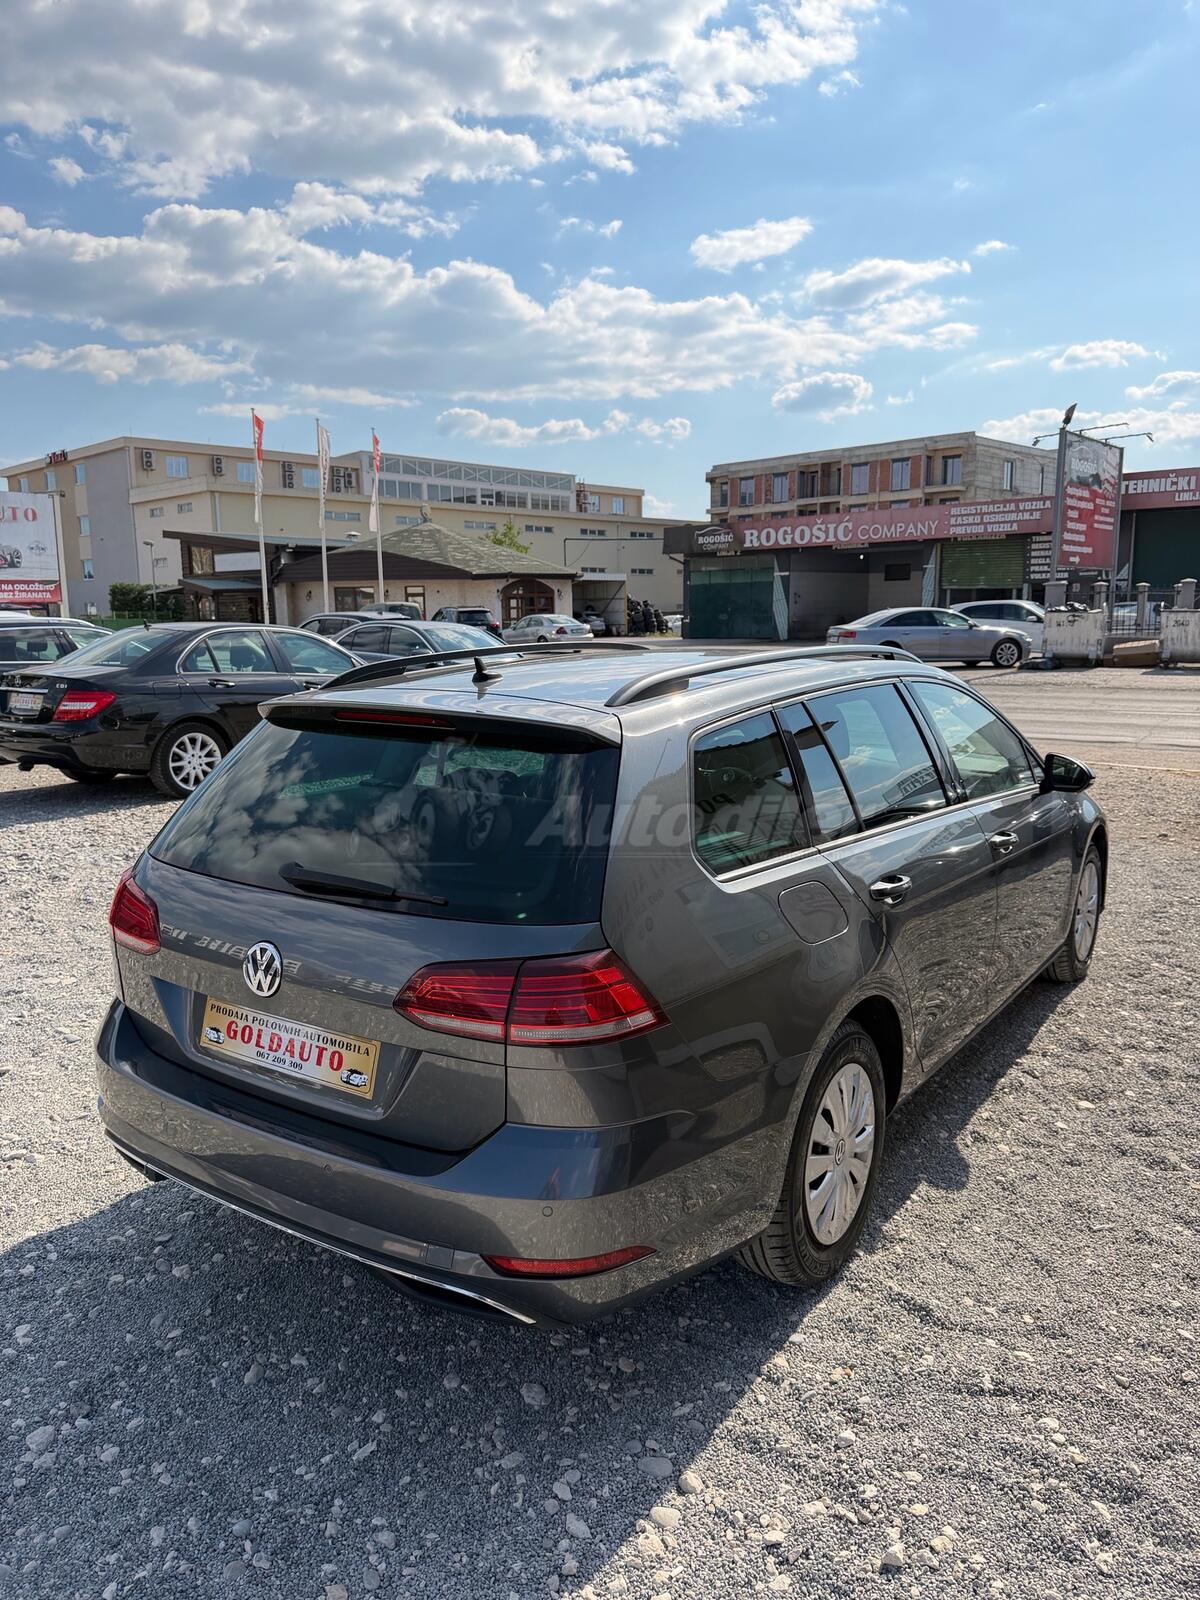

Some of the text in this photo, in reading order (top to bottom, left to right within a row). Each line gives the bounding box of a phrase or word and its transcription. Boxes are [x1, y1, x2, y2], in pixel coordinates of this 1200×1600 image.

[1121, 473, 1197, 495] TEHNIČKI
[1175, 491, 1200, 502] LINIJ
[951, 500, 1051, 515] REGISTRACIJA VOZILA
[950, 511, 1042, 525] KASKO OSIGURANJE
[744, 516, 939, 548] ROGOŠIĆ COMPANY
[987, 523, 1018, 532] VOZILA
[698, 532, 734, 544] ROGOŠIĆ
[210, 1003, 370, 1057] PRODAJA POLOVNIH AUTOMOBILA
[226, 1020, 344, 1072] GOLDAUTO
[256, 1049, 303, 1072] 067 209 309
